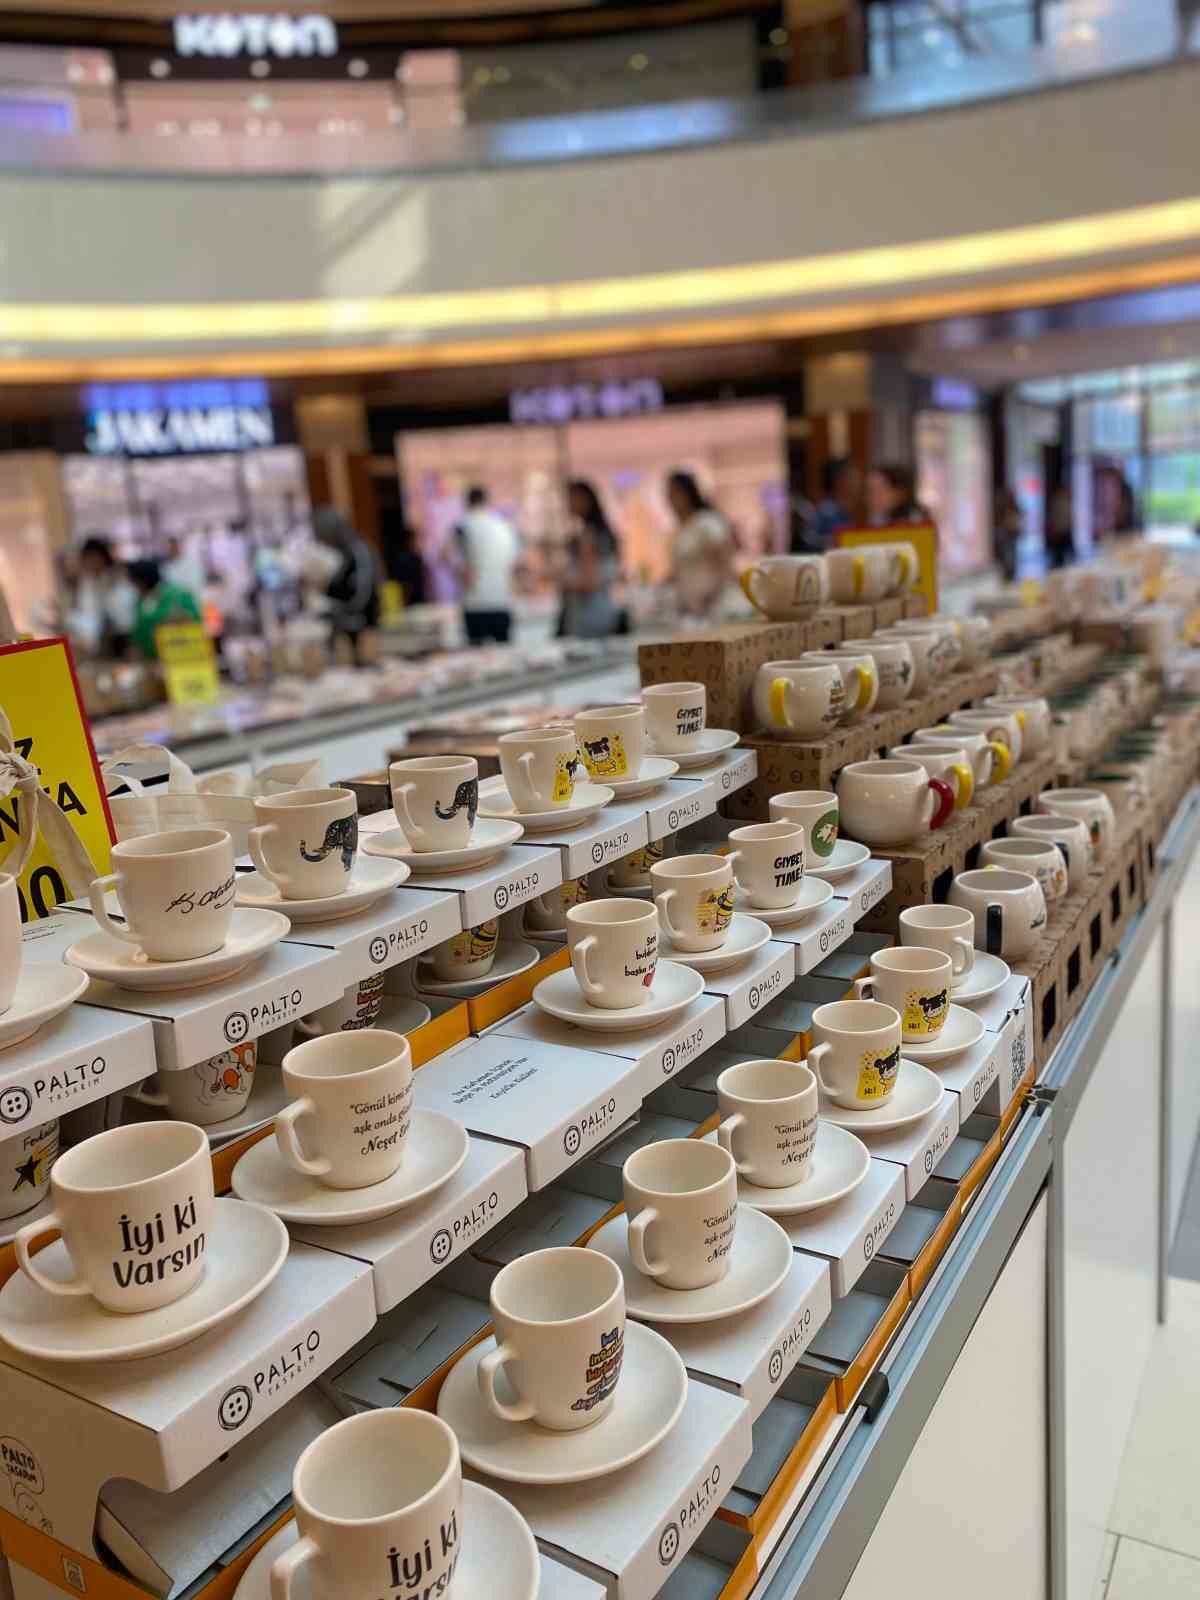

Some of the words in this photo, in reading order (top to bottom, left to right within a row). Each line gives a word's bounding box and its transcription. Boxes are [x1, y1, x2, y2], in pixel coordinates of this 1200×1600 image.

[508, 872, 539, 896] PALTO
[389, 919, 428, 947] PALTO
[250, 990, 302, 1023] PALTO
[676, 1028, 704, 1056] PALTO
[34, 1056, 106, 1098] PALTO
[581, 1097, 616, 1134] PALTO
[118, 1214, 165, 1256] İyi
[174, 1195, 196, 1235] ki
[453, 1191, 498, 1237] PALTO
[112, 1232, 205, 1288] Varsın
[783, 1308, 811, 1356] PALTO
[254, 1330, 320, 1393] PALTO
[1, 1443, 34, 1471] PALTO
[680, 1464, 721, 1528] PALTO
[386, 1546, 433, 1588] İyi
[440, 1509, 457, 1556] ki
